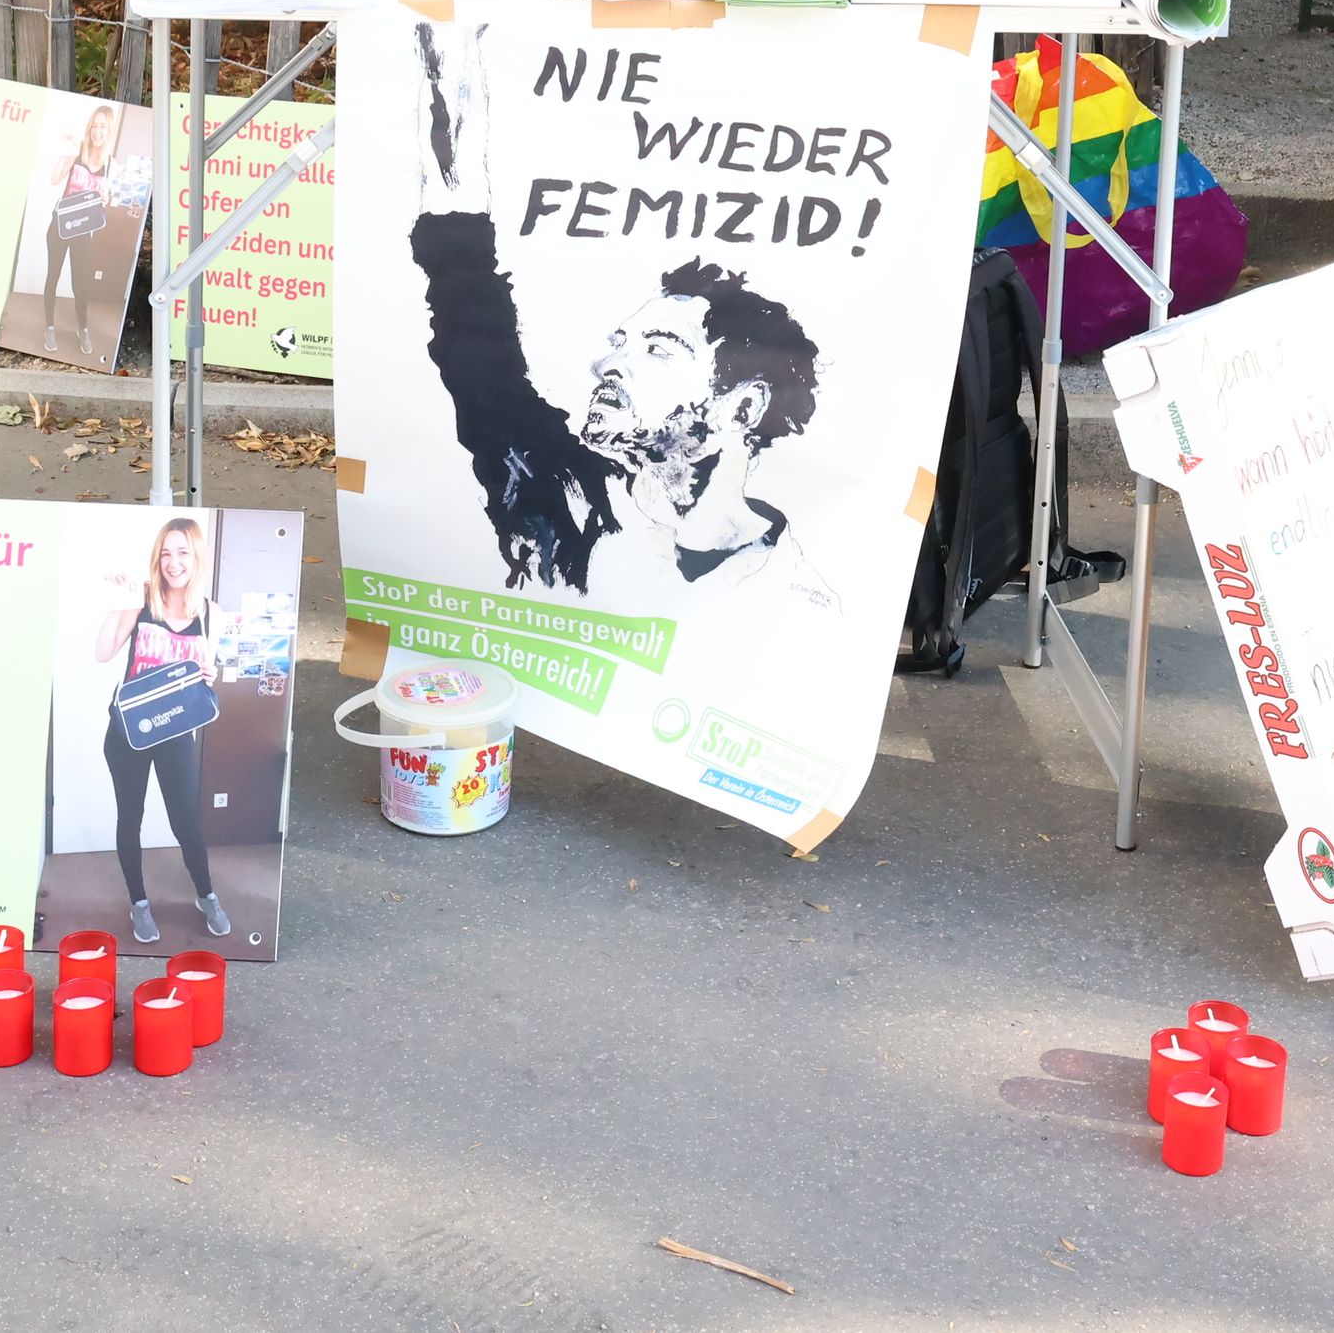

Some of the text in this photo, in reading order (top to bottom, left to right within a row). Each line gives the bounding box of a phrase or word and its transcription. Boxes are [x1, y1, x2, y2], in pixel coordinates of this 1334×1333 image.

[533, 46, 662, 105] NIE
[1, 99, 32, 124] für
[633, 110, 892, 185] WIEDER
[518, 177, 884, 258] FEMIZID!
[258, 274, 326, 301] gegen
[302, 334, 329, 344] WILPF
[362, 576, 665, 660] StoP der Partnergewalt
[1269, 629, 1279, 643] EN
[400, 622, 461, 654] ganz
[471, 627, 605, 700] Österreich!
[1204, 543, 1309, 760] FRES-LUZ
[1274, 643, 1296, 695] PRODUCIDO
[389, 747, 428, 774] FUN
[462, 780, 480, 794] 20
